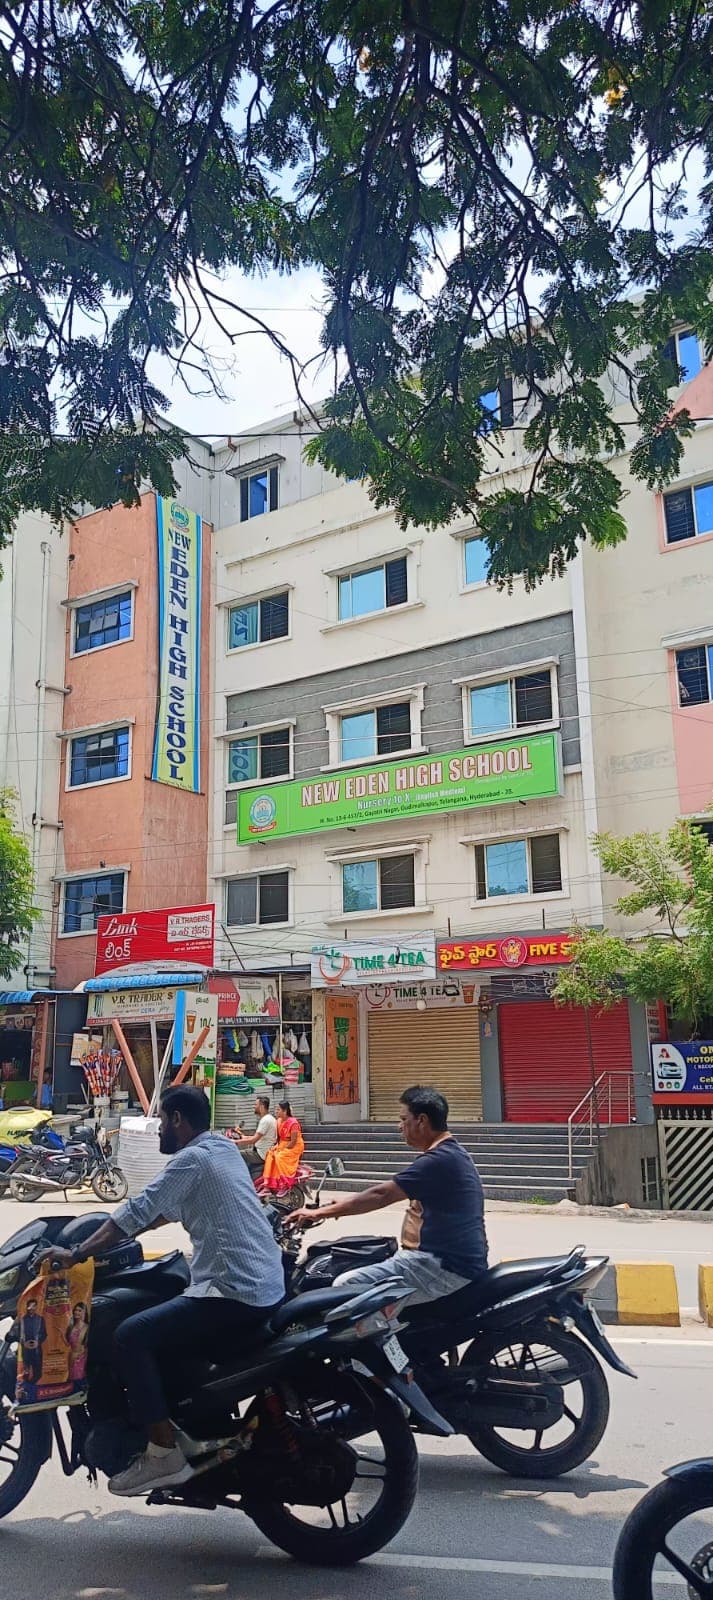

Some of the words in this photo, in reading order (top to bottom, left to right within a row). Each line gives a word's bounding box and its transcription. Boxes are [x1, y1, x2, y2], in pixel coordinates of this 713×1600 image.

[168, 527, 191, 551] NEW
[169, 546, 189, 610] EDEN
[168, 613, 189, 680] HIGH
[166, 685, 187, 781] SCHOOL
[301, 780, 340, 807] NEW
[344, 771, 390, 799] EDEN
[395, 762, 443, 791] HIGH
[448, 746, 532, 782] SCHOOL
[352, 954, 384, 971] TIME
[388, 953, 396, 968] 4
[400, 951, 426, 966] TEA
[530, 943, 558, 956] FIVE
[393, 986, 418, 998] TIME
[420, 986, 427, 997] 4
